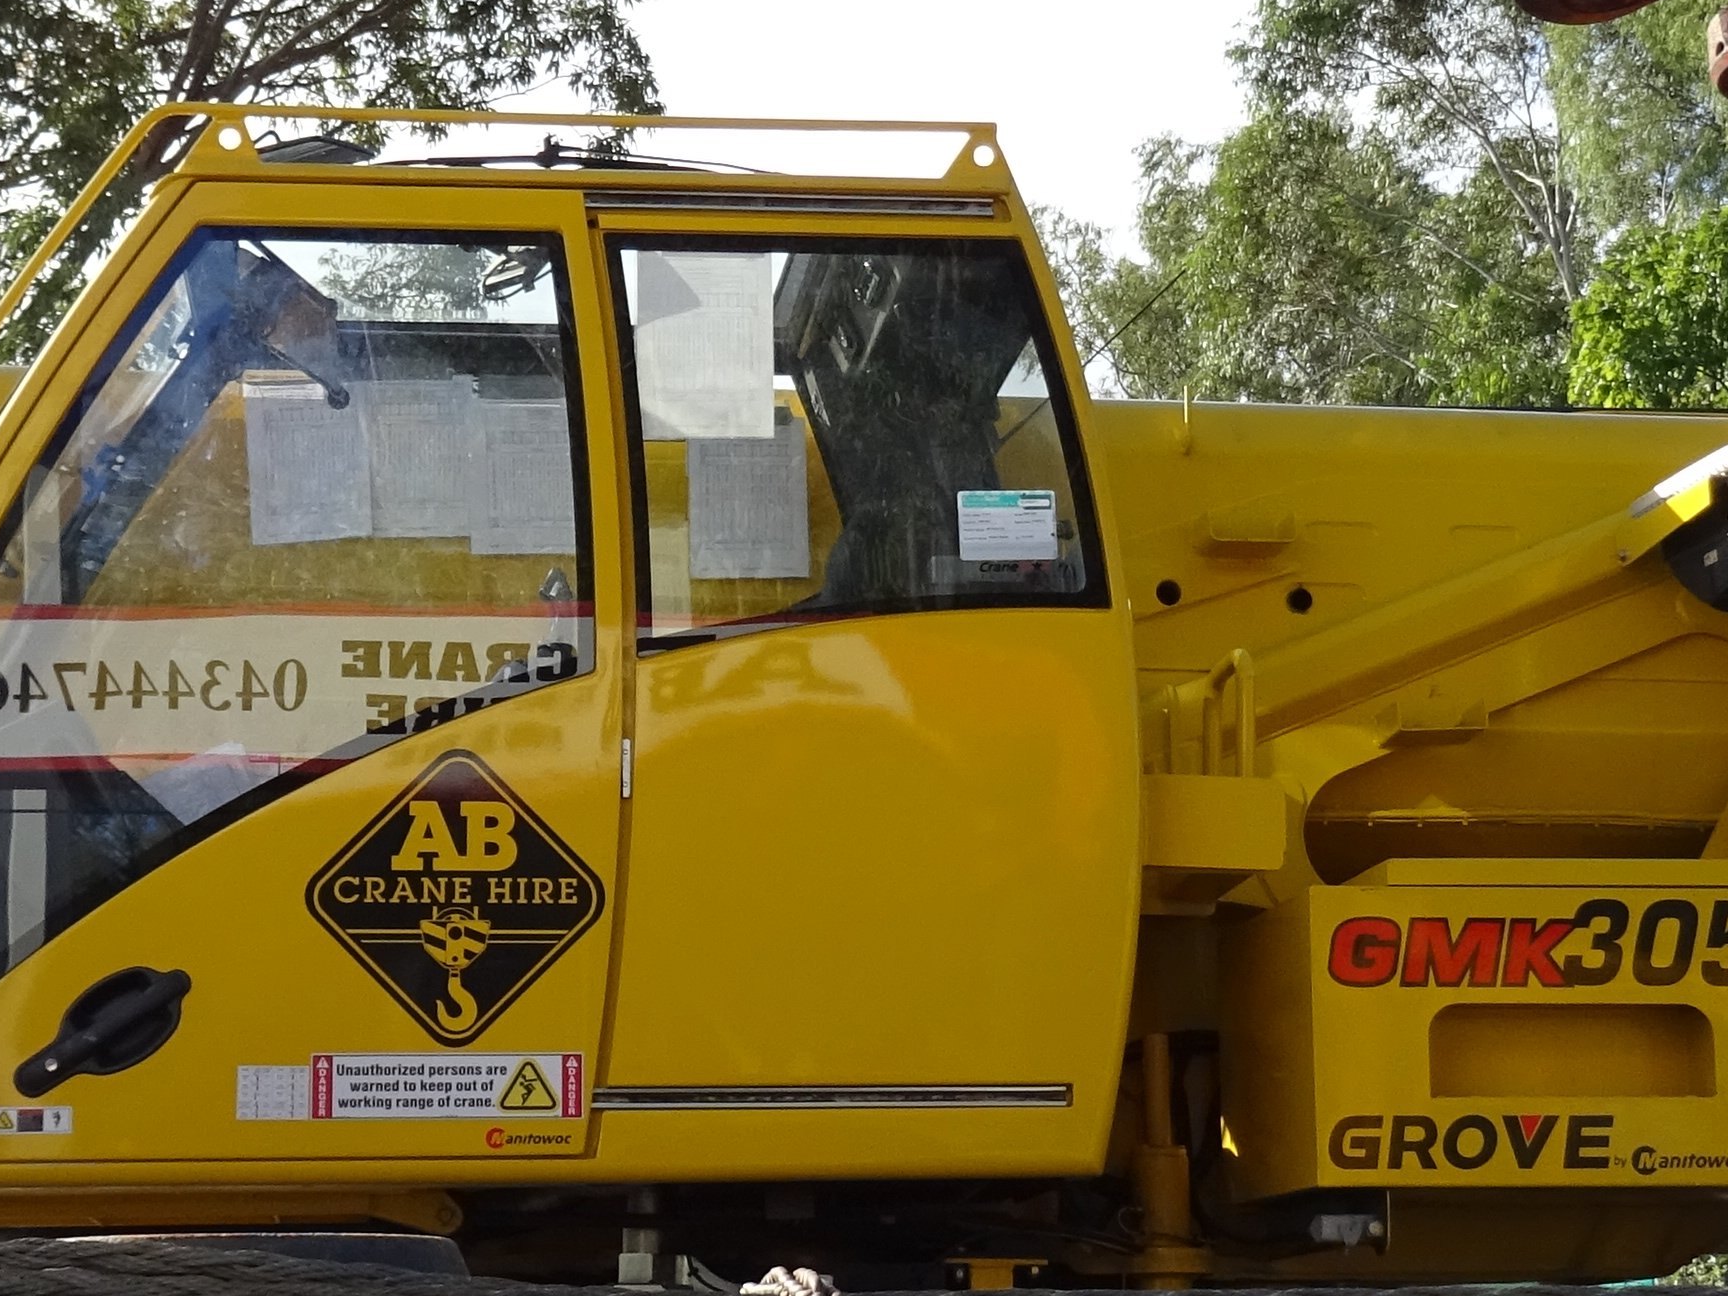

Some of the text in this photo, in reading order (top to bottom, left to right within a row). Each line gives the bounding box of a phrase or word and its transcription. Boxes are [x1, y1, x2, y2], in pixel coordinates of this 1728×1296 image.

[391, 801, 518, 872] AB
[334, 876, 578, 904] CRANE HIRE
[336, 1064, 507, 1078] Unauthorized persons are
[350, 1080, 494, 1095] warned to keep out of
[318, 1069, 326, 1116] DANGER
[338, 1096, 496, 1109] working range of crane.
[568, 1068, 576, 1115] DANGER
[1328, 1114, 1614, 1170] GROVE
[1613, 1155, 1627, 1168] by
